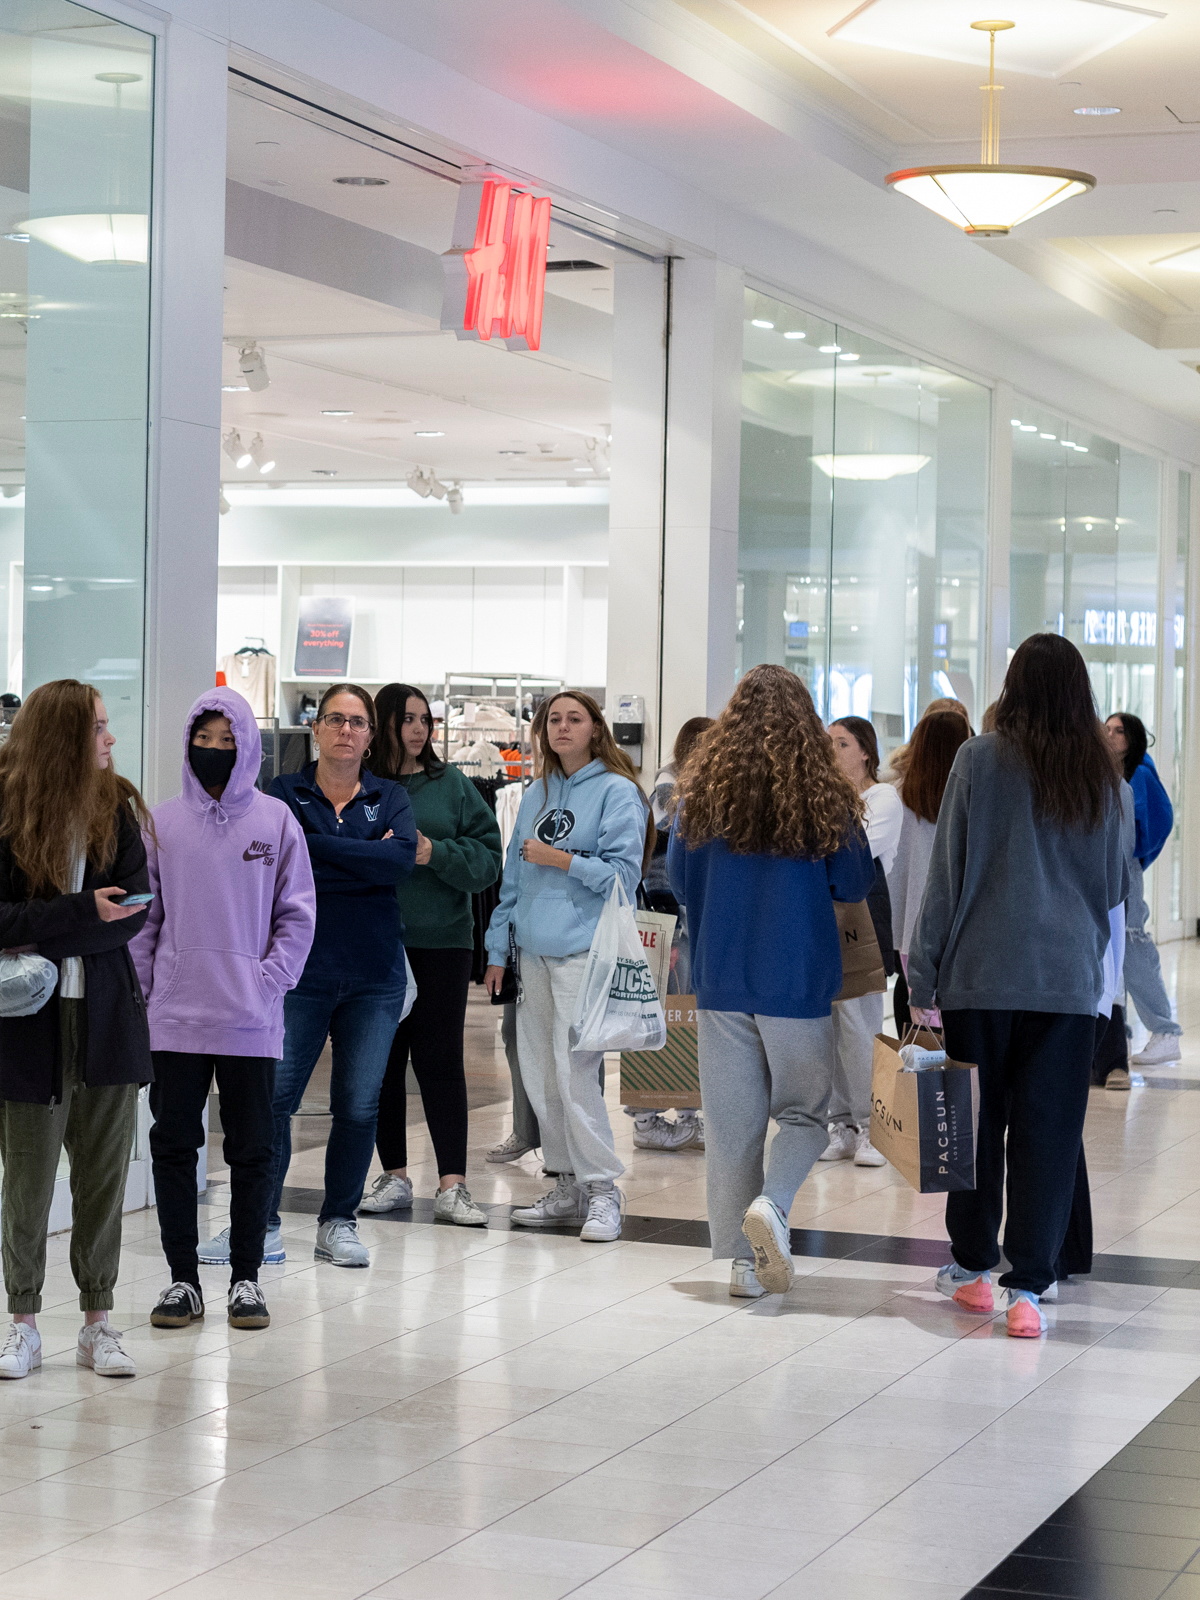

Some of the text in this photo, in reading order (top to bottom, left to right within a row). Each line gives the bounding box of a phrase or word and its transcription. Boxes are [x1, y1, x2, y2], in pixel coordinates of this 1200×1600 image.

[310, 629, 339, 638] 30% off
[303, 640, 345, 648] everything
[250, 840, 273, 853] NIKE
[262, 856, 275, 867] SB
[936, 1091, 949, 1174] PACSUN
